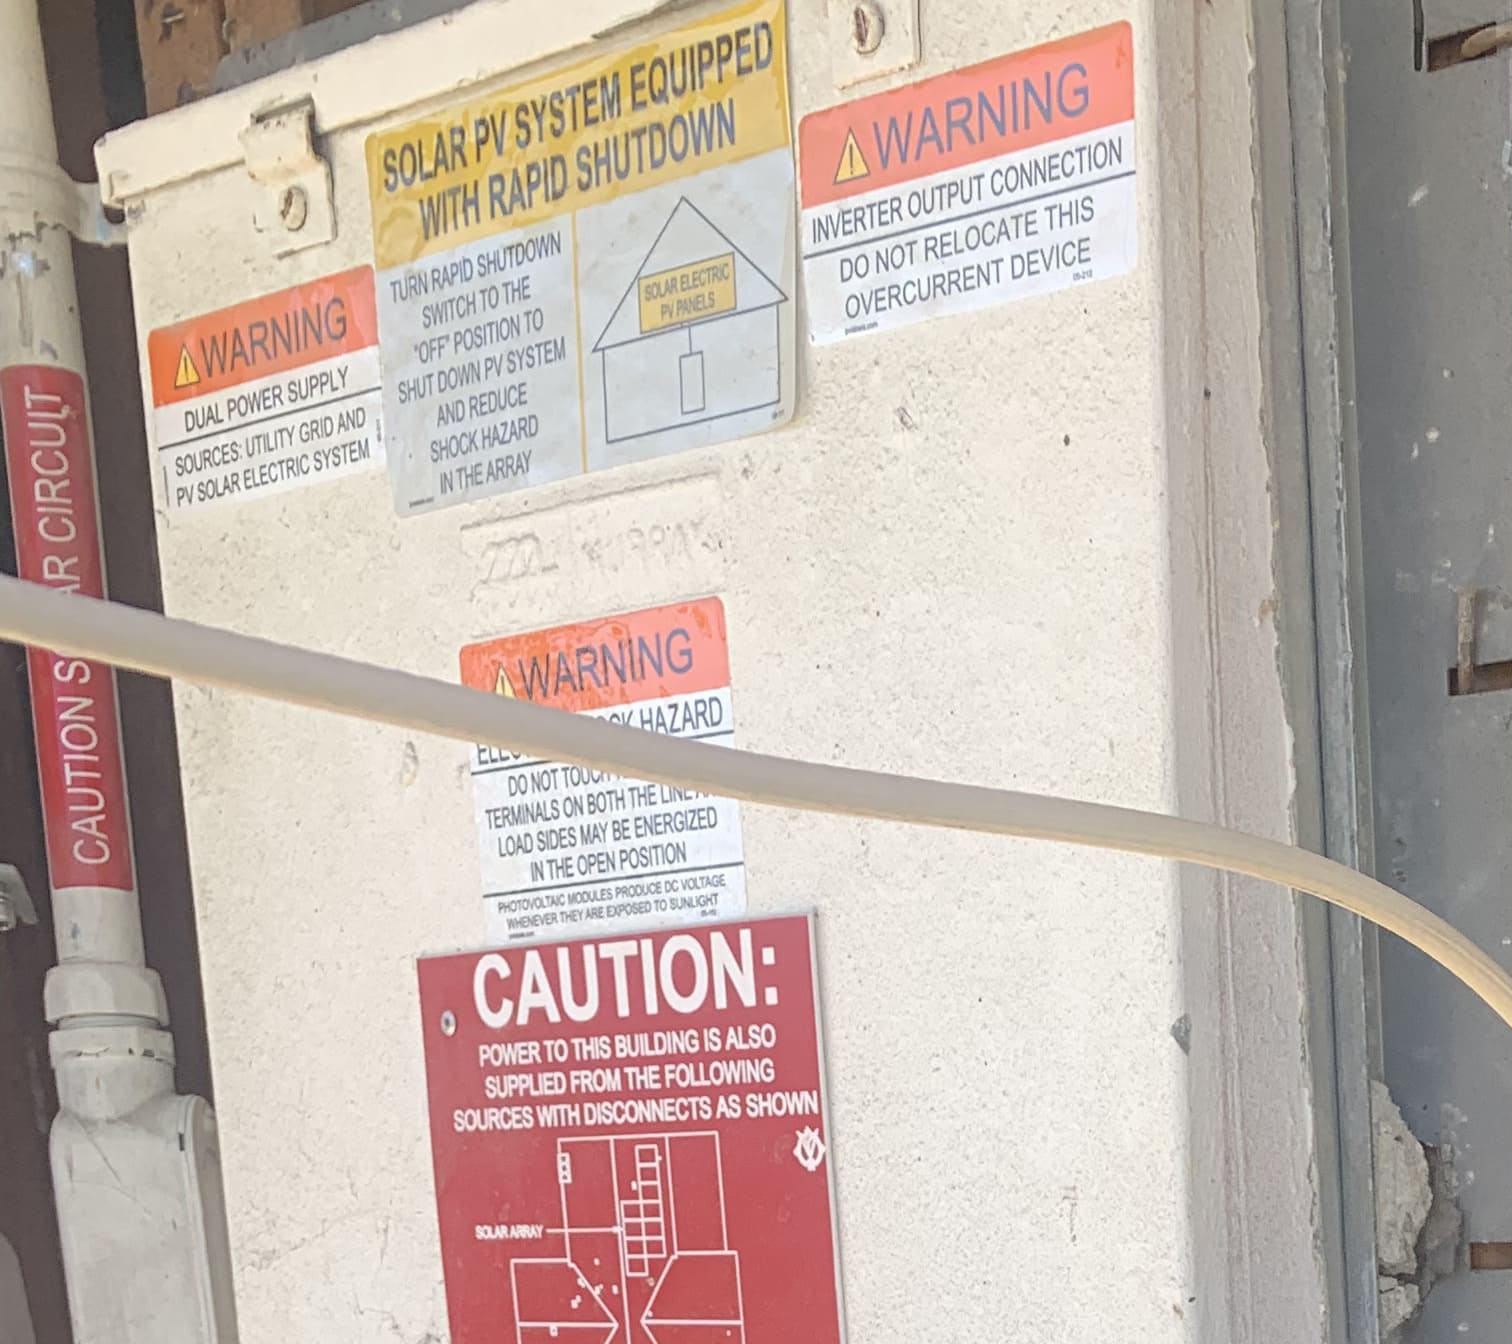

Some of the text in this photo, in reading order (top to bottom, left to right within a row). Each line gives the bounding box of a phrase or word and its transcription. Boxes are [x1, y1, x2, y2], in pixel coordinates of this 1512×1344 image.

[383, 21, 773, 193] SOLAR PV SYSTEM EQUIPPED
[873, 63, 1089, 169] WARNING
[419, 98, 736, 241] WITH RAPID SHUTDOWN
[812, 136, 1123, 244] INVERTER OUTPUT CONNECTION
[839, 195, 1095, 283] DO NOT RELOCATE THIS
[390, 231, 561, 303] TURN RAPID SHUTDOWN
[644, 263, 730, 301] SOLAR ELECTRIC
[845, 237, 1091, 319] OVERCURRENT DEVICE
[422, 276, 531, 329] SWITCH TO THE
[660, 292, 715, 321] PV PANELS
[201, 297, 347, 378] WARNING
[454, 317, 520, 355] POSITION
[525, 308, 544, 334] TO
[398, 336, 566, 404] SHUT DOWN PV SYSTEM
[185, 366, 349, 432] DUAL POWER SUPPLY
[437, 382, 528, 427] AND REDUCE
[24, 384, 74, 544] CIRCUIT
[175, 441, 243, 477] SOURCES:
[246, 426, 296, 457] UTILITY
[299, 416, 333, 442] GRID
[337, 407, 366, 432] AND
[430, 415, 539, 462] SHOCK HAZARD
[177, 438, 370, 507] PV SOLAR ELECTRIC SYSTEM
[440, 450, 532, 494] IN THE ARRAY
[519, 627, 694, 700] WARNING
[640, 696, 723, 735] HAZARD
[58, 696, 111, 865] CAUTION
[508, 773, 528, 797] DO
[531, 769, 558, 793] NOT
[485, 799, 560, 830] TERMINALS
[563, 796, 584, 818] ON
[587, 789, 625, 815] BOTH
[628, 785, 656, 807] THE
[498, 806, 718, 857] LOAD SIDES MAY BE ENERGIZED
[531, 841, 687, 882] IN THE OPEN POSITION
[498, 874, 726, 913] PHOTOVOLTAIC MODULES PRODUCE DC VOLTAGE
[507, 893, 719, 930] WHENEVER THEY ARE EXPOSED TO SUNLIGHT
[473, 928, 779, 1029] CAUTION:
[479, 1023, 776, 1067] POWER TO THIS BUILDING IS ALSO
[485, 1058, 775, 1099] SUPPLIED FROM THE FOLLOWING
[453, 1090, 819, 1132] SOURCES WITH DISCONNECTS AS SHOWN
[475, 1224, 544, 1240] SOLAR ARRAY
